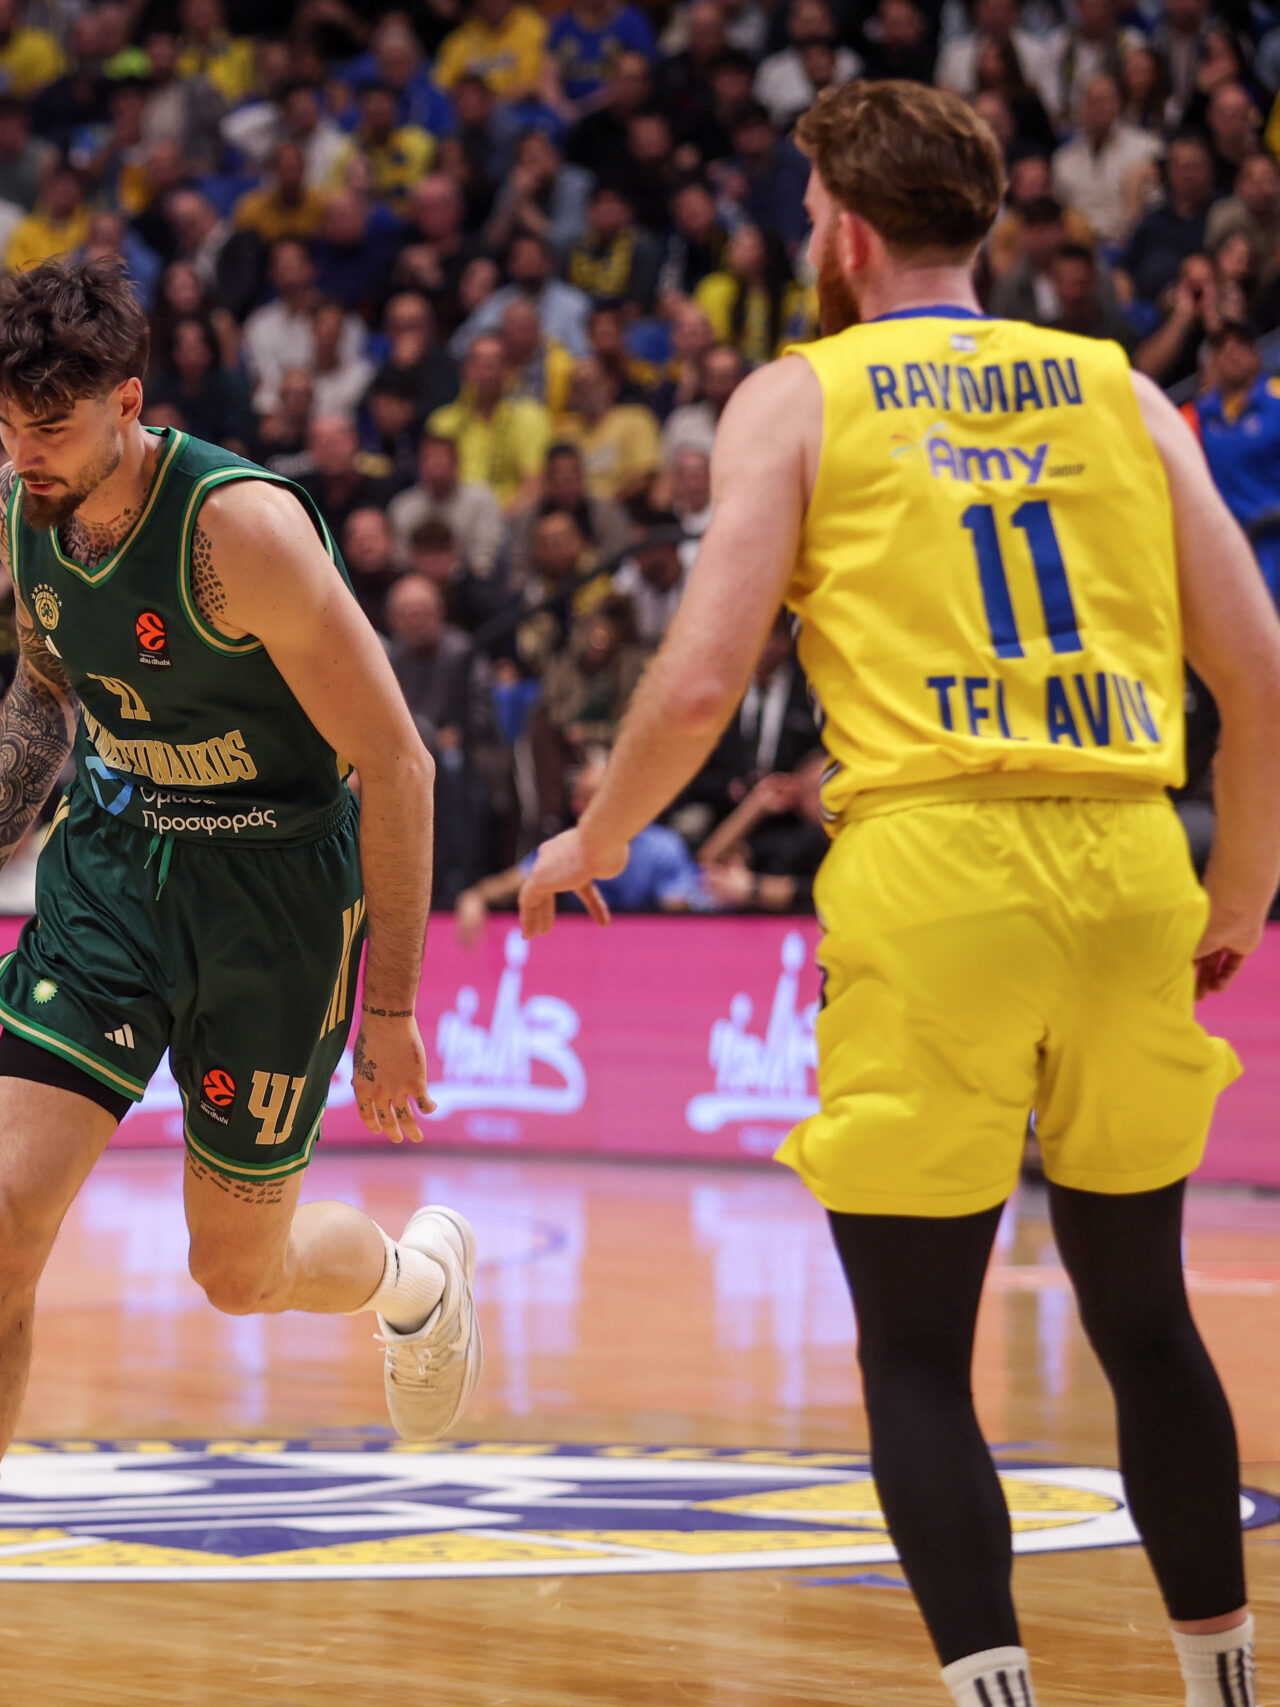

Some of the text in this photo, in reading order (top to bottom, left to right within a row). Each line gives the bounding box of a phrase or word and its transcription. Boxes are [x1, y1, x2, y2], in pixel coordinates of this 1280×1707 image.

[866, 357, 1083, 413] RAYMAN
[924, 438, 1050, 485] Amy
[961, 500, 1084, 659] 11
[926, 671, 1160, 748] TEL AVIV
[142, 806, 277, 836] Προσφοράς
[247, 1070, 307, 1145] 41
